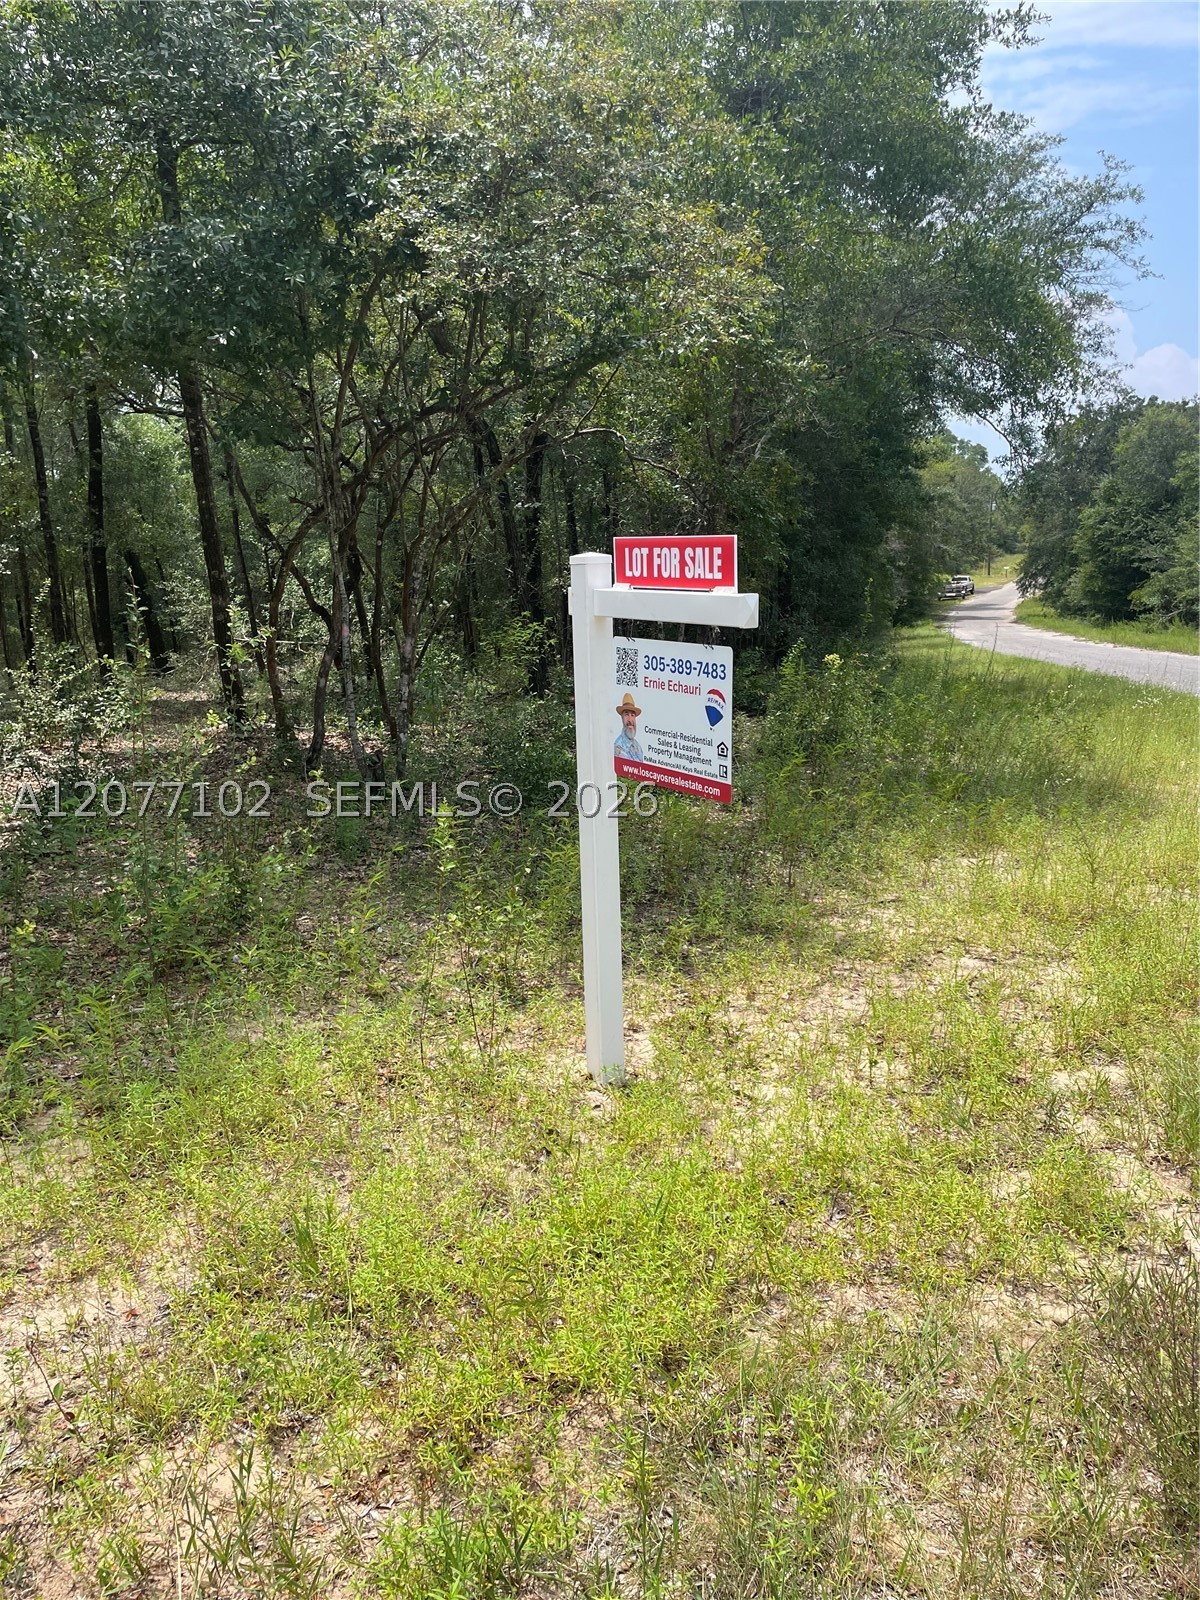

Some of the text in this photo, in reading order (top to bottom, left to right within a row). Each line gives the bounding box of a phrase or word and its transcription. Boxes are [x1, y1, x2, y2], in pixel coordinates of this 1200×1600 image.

[624, 546, 723, 580] LOT FOR SALE
[643, 654, 727, 680] 305-389-7483
[643, 676, 702, 696] Ernie Echauri
[644, 725, 713, 747] Commercial-Residential
[647, 744, 712, 767] Property Management
[657, 738, 702, 757] Sales & Leasing
[622, 764, 721, 797] www.loscayosrealestate.com
[693, 768, 704, 776] Real
[704, 770, 718, 779] Estate
